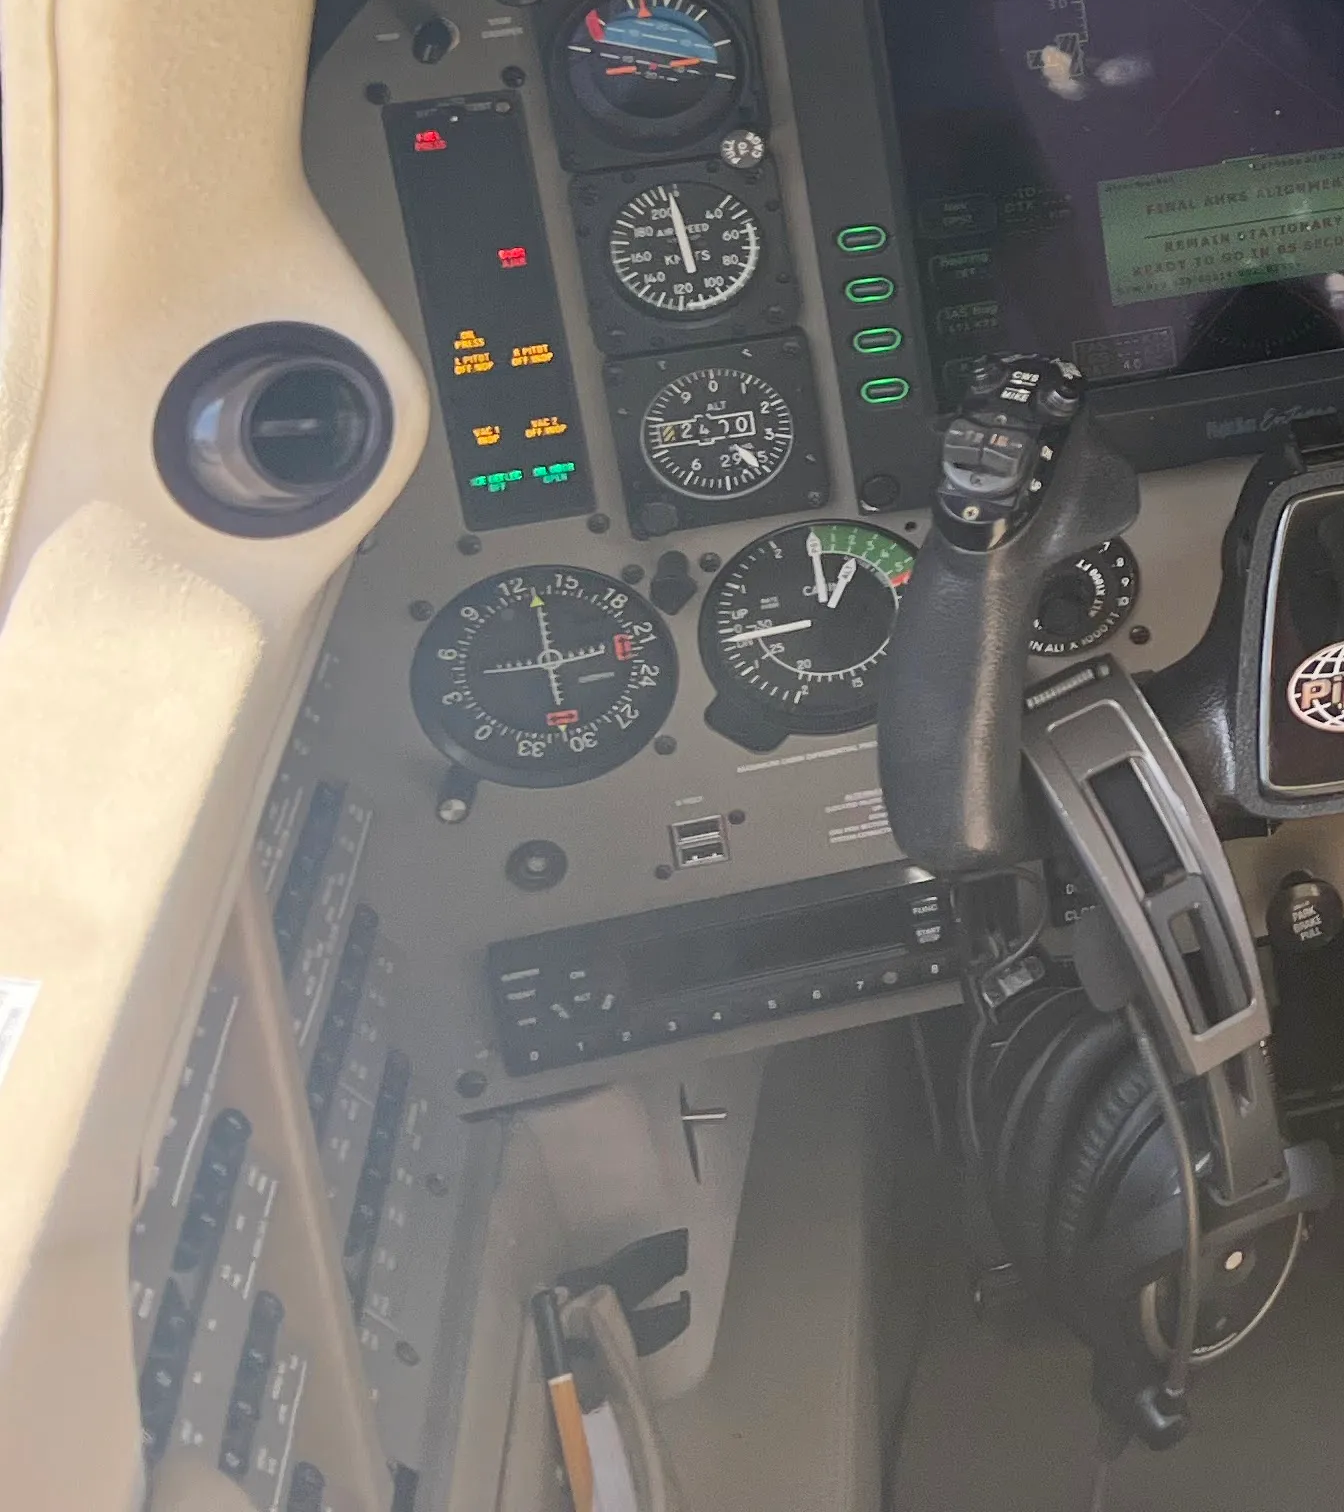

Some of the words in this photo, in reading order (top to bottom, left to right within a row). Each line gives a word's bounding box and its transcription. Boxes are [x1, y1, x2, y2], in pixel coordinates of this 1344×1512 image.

[722, 228, 740, 241] 60
[1163, 232, 1231, 253] REMAIN
[1239, 214, 1344, 243] STATIONARY
[722, 254, 739, 266] 80
[673, 282, 694, 294] 120
[704, 275, 724, 288] 100
[706, 400, 727, 412] ALT
[499, 577, 527, 596] 12
[555, 573, 579, 590] 15
[602, 588, 629, 610] 18
[633, 622, 657, 644] 21
[769, 643, 785, 654] 25
[640, 665, 660, 688] 24
[614, 706, 640, 730] 27
[517, 740, 547, 758] 33
[569, 731, 598, 753] 30
